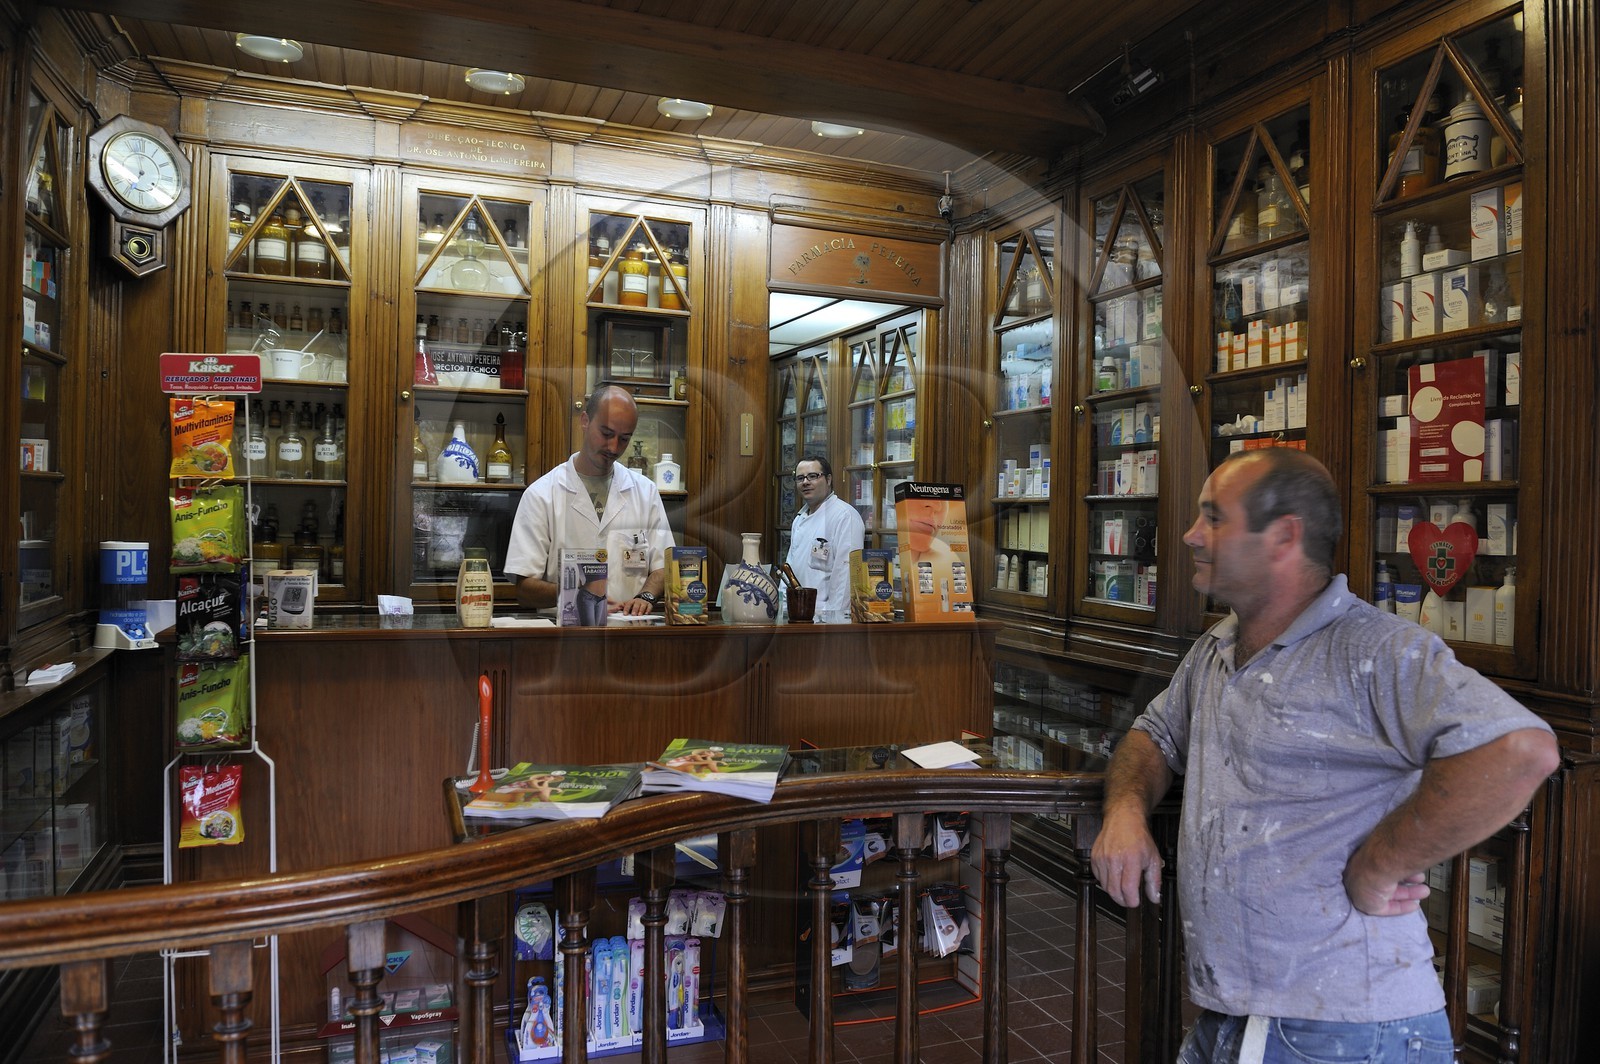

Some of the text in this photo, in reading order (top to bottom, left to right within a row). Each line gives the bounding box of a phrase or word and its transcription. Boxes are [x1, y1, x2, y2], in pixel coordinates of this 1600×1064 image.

[406, 146, 422, 154] DR.
[788, 238, 921, 288] FARMACIA PEREIRA
[447, 352, 472, 364] ANTONIO
[474, 354, 500, 365] PEREIRA
[188, 362, 234, 373] Kaiser
[466, 366, 498, 374] TECNICO
[165, 376, 210, 384] REBUÇADOS
[1450, 392, 1481, 400] Reclamações
[174, 413, 232, 436] Multivitaminas
[910, 484, 950, 495] Neutrogena
[180, 595, 225, 616] Alcaçuz
[270, 598, 278, 627] PULSO
[179, 678, 230, 702] Anis-Funcho
[567, 770, 630, 779] SAÚDE
[411, 1011, 442, 1020] VapoSpray
